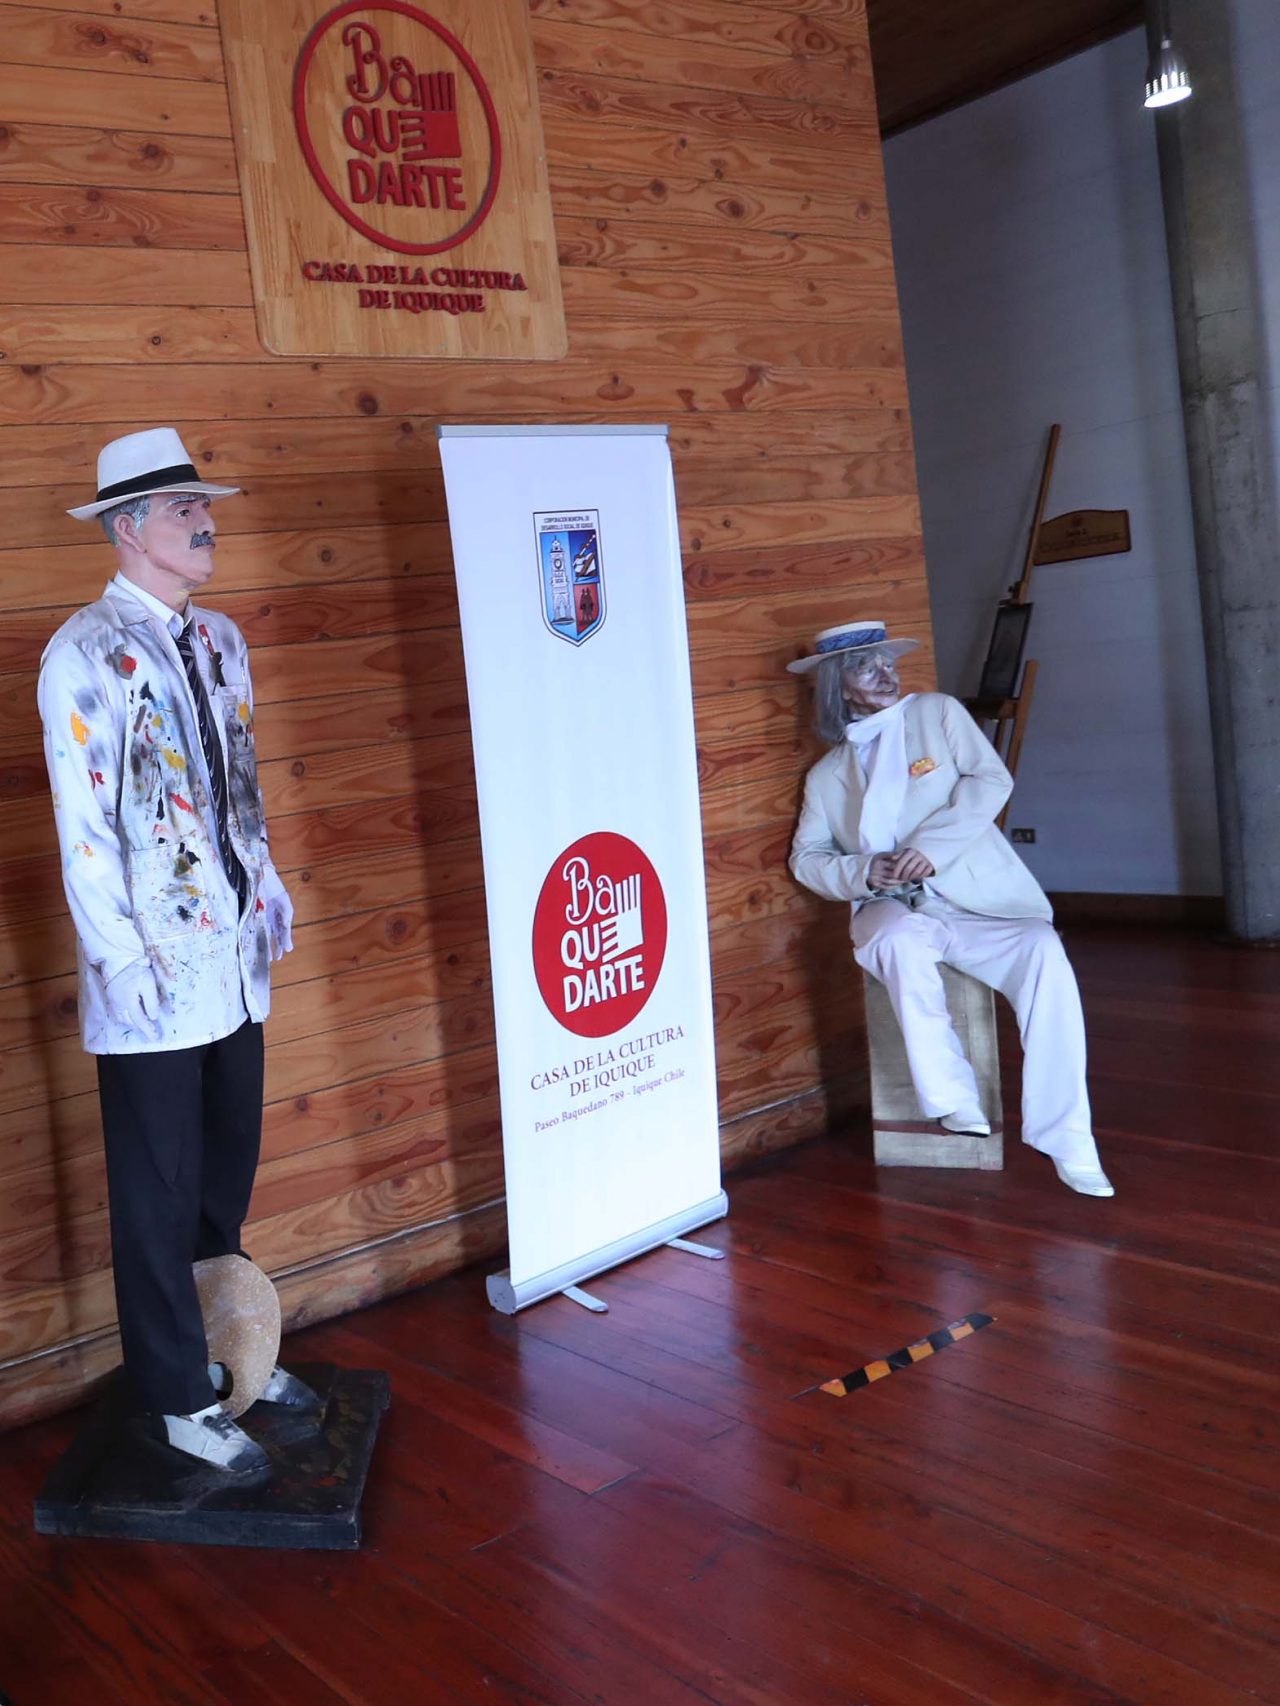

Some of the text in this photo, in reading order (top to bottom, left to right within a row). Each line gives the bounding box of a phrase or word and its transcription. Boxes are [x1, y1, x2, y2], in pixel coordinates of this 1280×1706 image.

[343, 106, 427, 162] QUE
[347, 158, 467, 211] DARTE
[302, 261, 528, 291] CASA DE LA CULTURA
[358, 289, 486, 315] DE IQUIQUE
[560, 916, 620, 970] QUE
[563, 954, 645, 1013] DARTE
[530, 1025, 684, 1090] CASA DE LA CULTURA
[570, 1054, 656, 1098] DE IQUIQUE
[534, 1117, 560, 1133] Paseo
[561, 1098, 608, 1123] Baquedano
[610, 1090, 625, 1102] 789
[633, 1077, 663, 1096] Iquique
[663, 1068, 686, 1083] Chile
